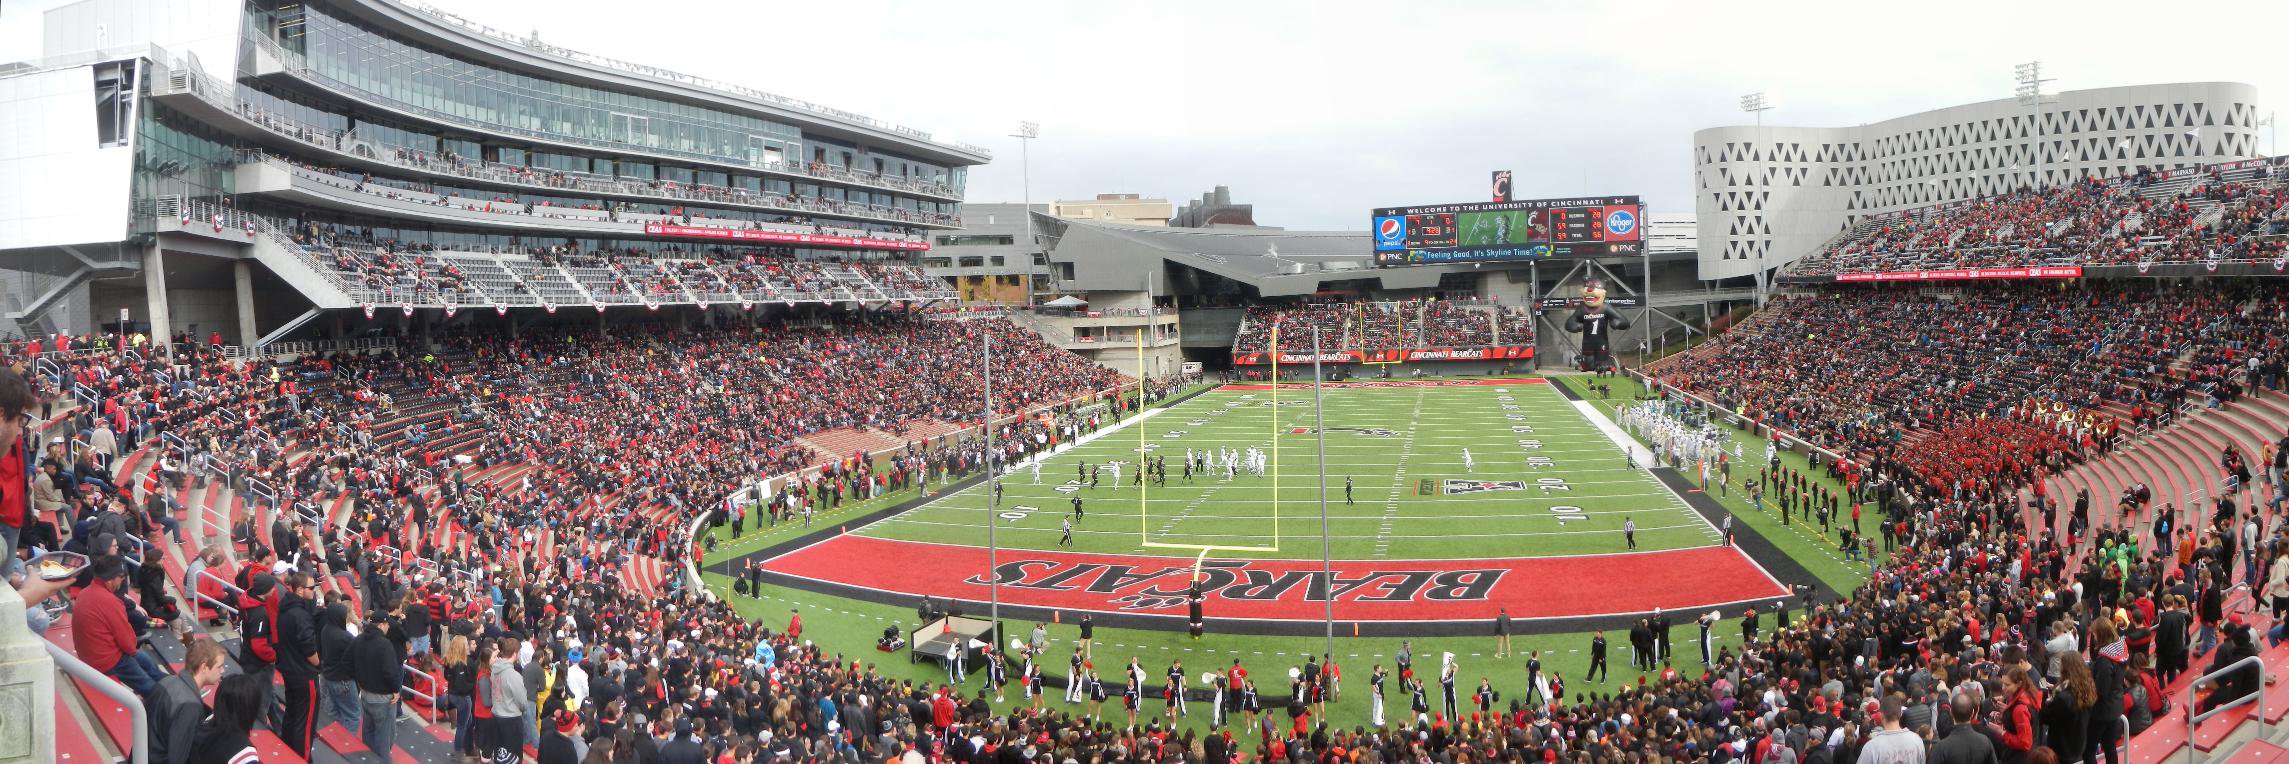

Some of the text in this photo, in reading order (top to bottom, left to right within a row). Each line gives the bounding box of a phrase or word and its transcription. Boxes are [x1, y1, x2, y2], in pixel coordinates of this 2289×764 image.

[1407, 206, 1447, 214] WELCOME
[1482, 202, 1533, 210] UNIVERSITY
[1551, 199, 1604, 207] CINCINNATI
[1610, 214, 1634, 231] Kroger
[1427, 251, 1451, 260] Feeling
[1486, 248, 1512, 257] Skyline
[1513, 248, 1533, 256] Time!
[1619, 244, 1636, 252] PNC
[1281, 353, 1316, 362] CINCINNAT
[1410, 348, 1484, 359] CINCINNATI BEARCATS
[963, 560, 1512, 603] BEARCATS
